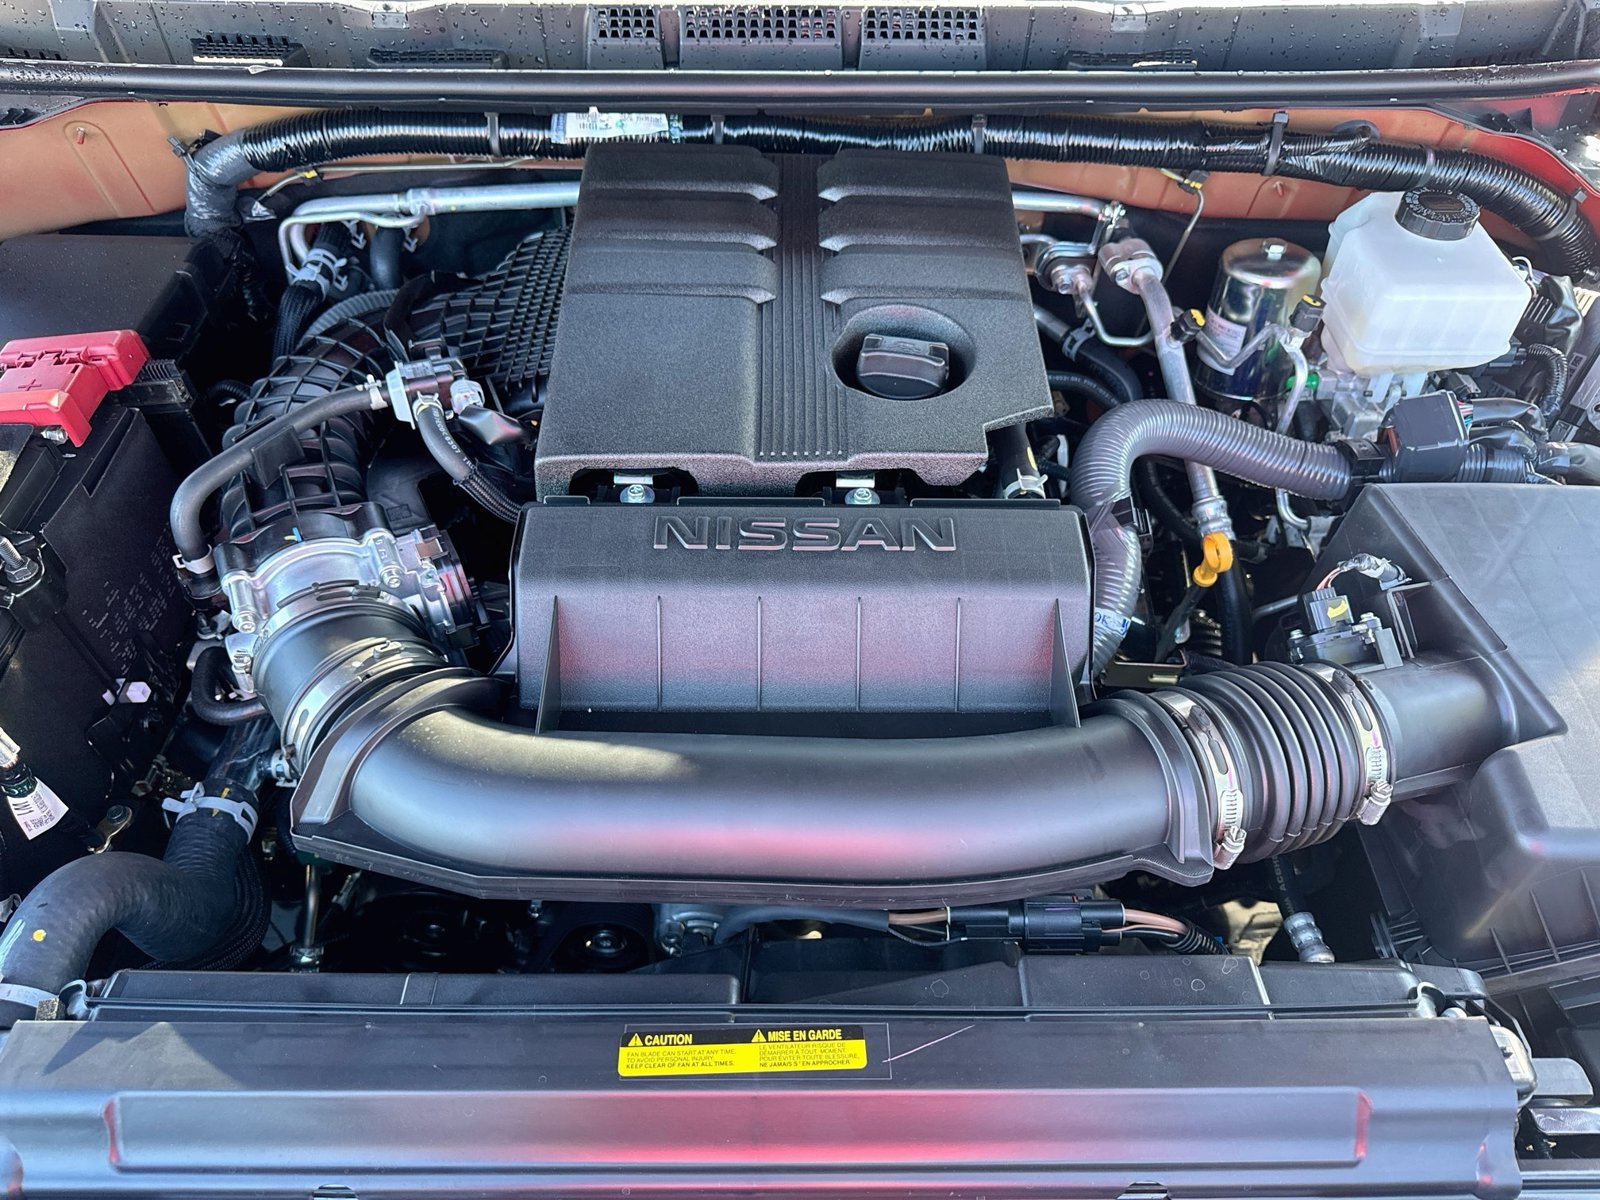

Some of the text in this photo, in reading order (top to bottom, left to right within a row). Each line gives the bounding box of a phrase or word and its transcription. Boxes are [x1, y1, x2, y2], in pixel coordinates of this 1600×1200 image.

[653, 515, 957, 551] NISSAN
[644, 1033, 693, 1046] CAUTION
[768, 1029, 842, 1042] MISE EN GARDE
